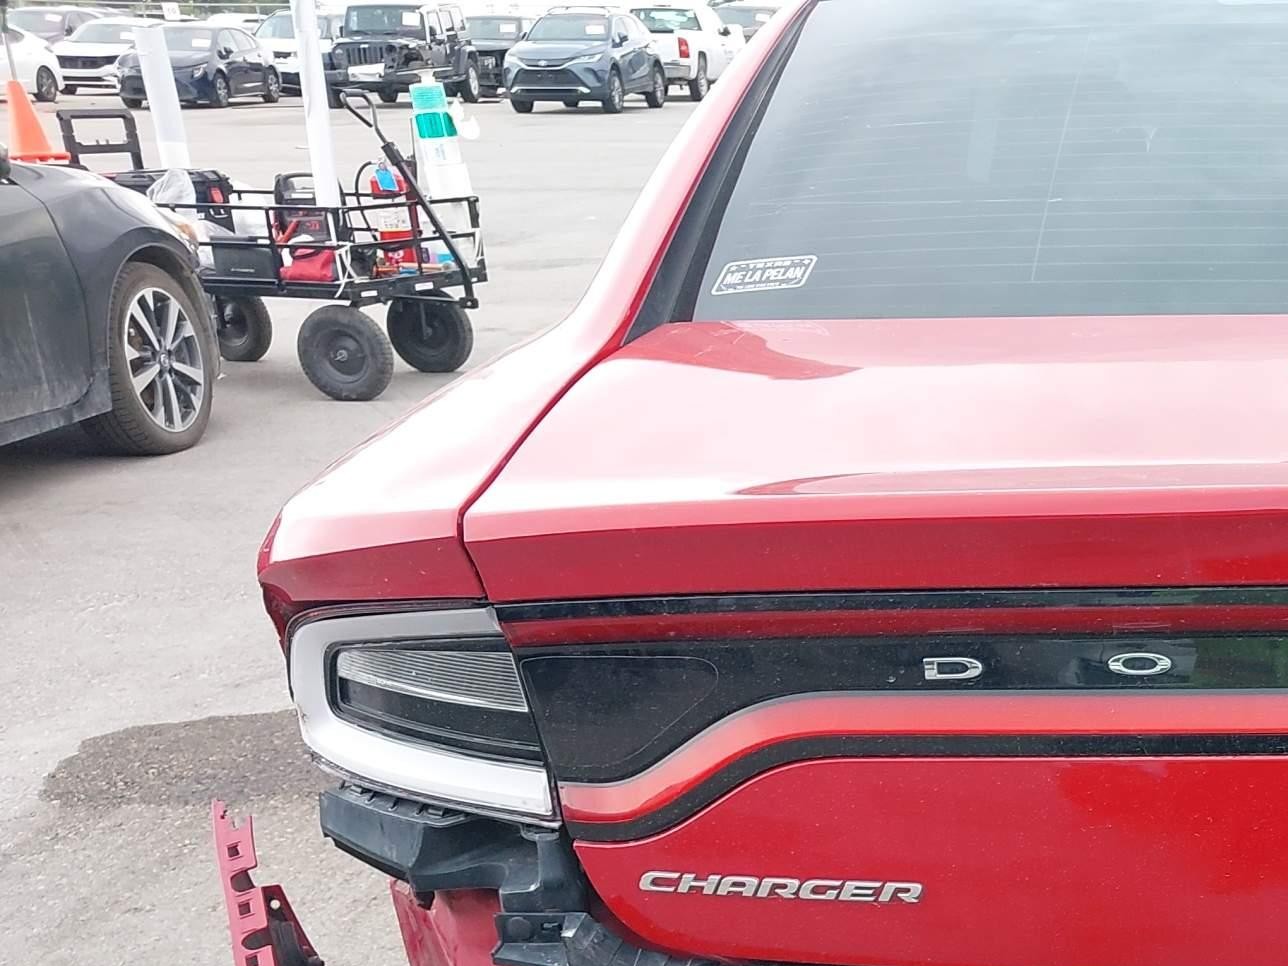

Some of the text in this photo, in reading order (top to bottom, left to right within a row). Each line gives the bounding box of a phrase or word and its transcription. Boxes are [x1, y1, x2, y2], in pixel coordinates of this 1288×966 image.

[723, 271, 746, 285] ME
[744, 269, 762, 283] LA
[638, 870, 923, 903] CHARGER
